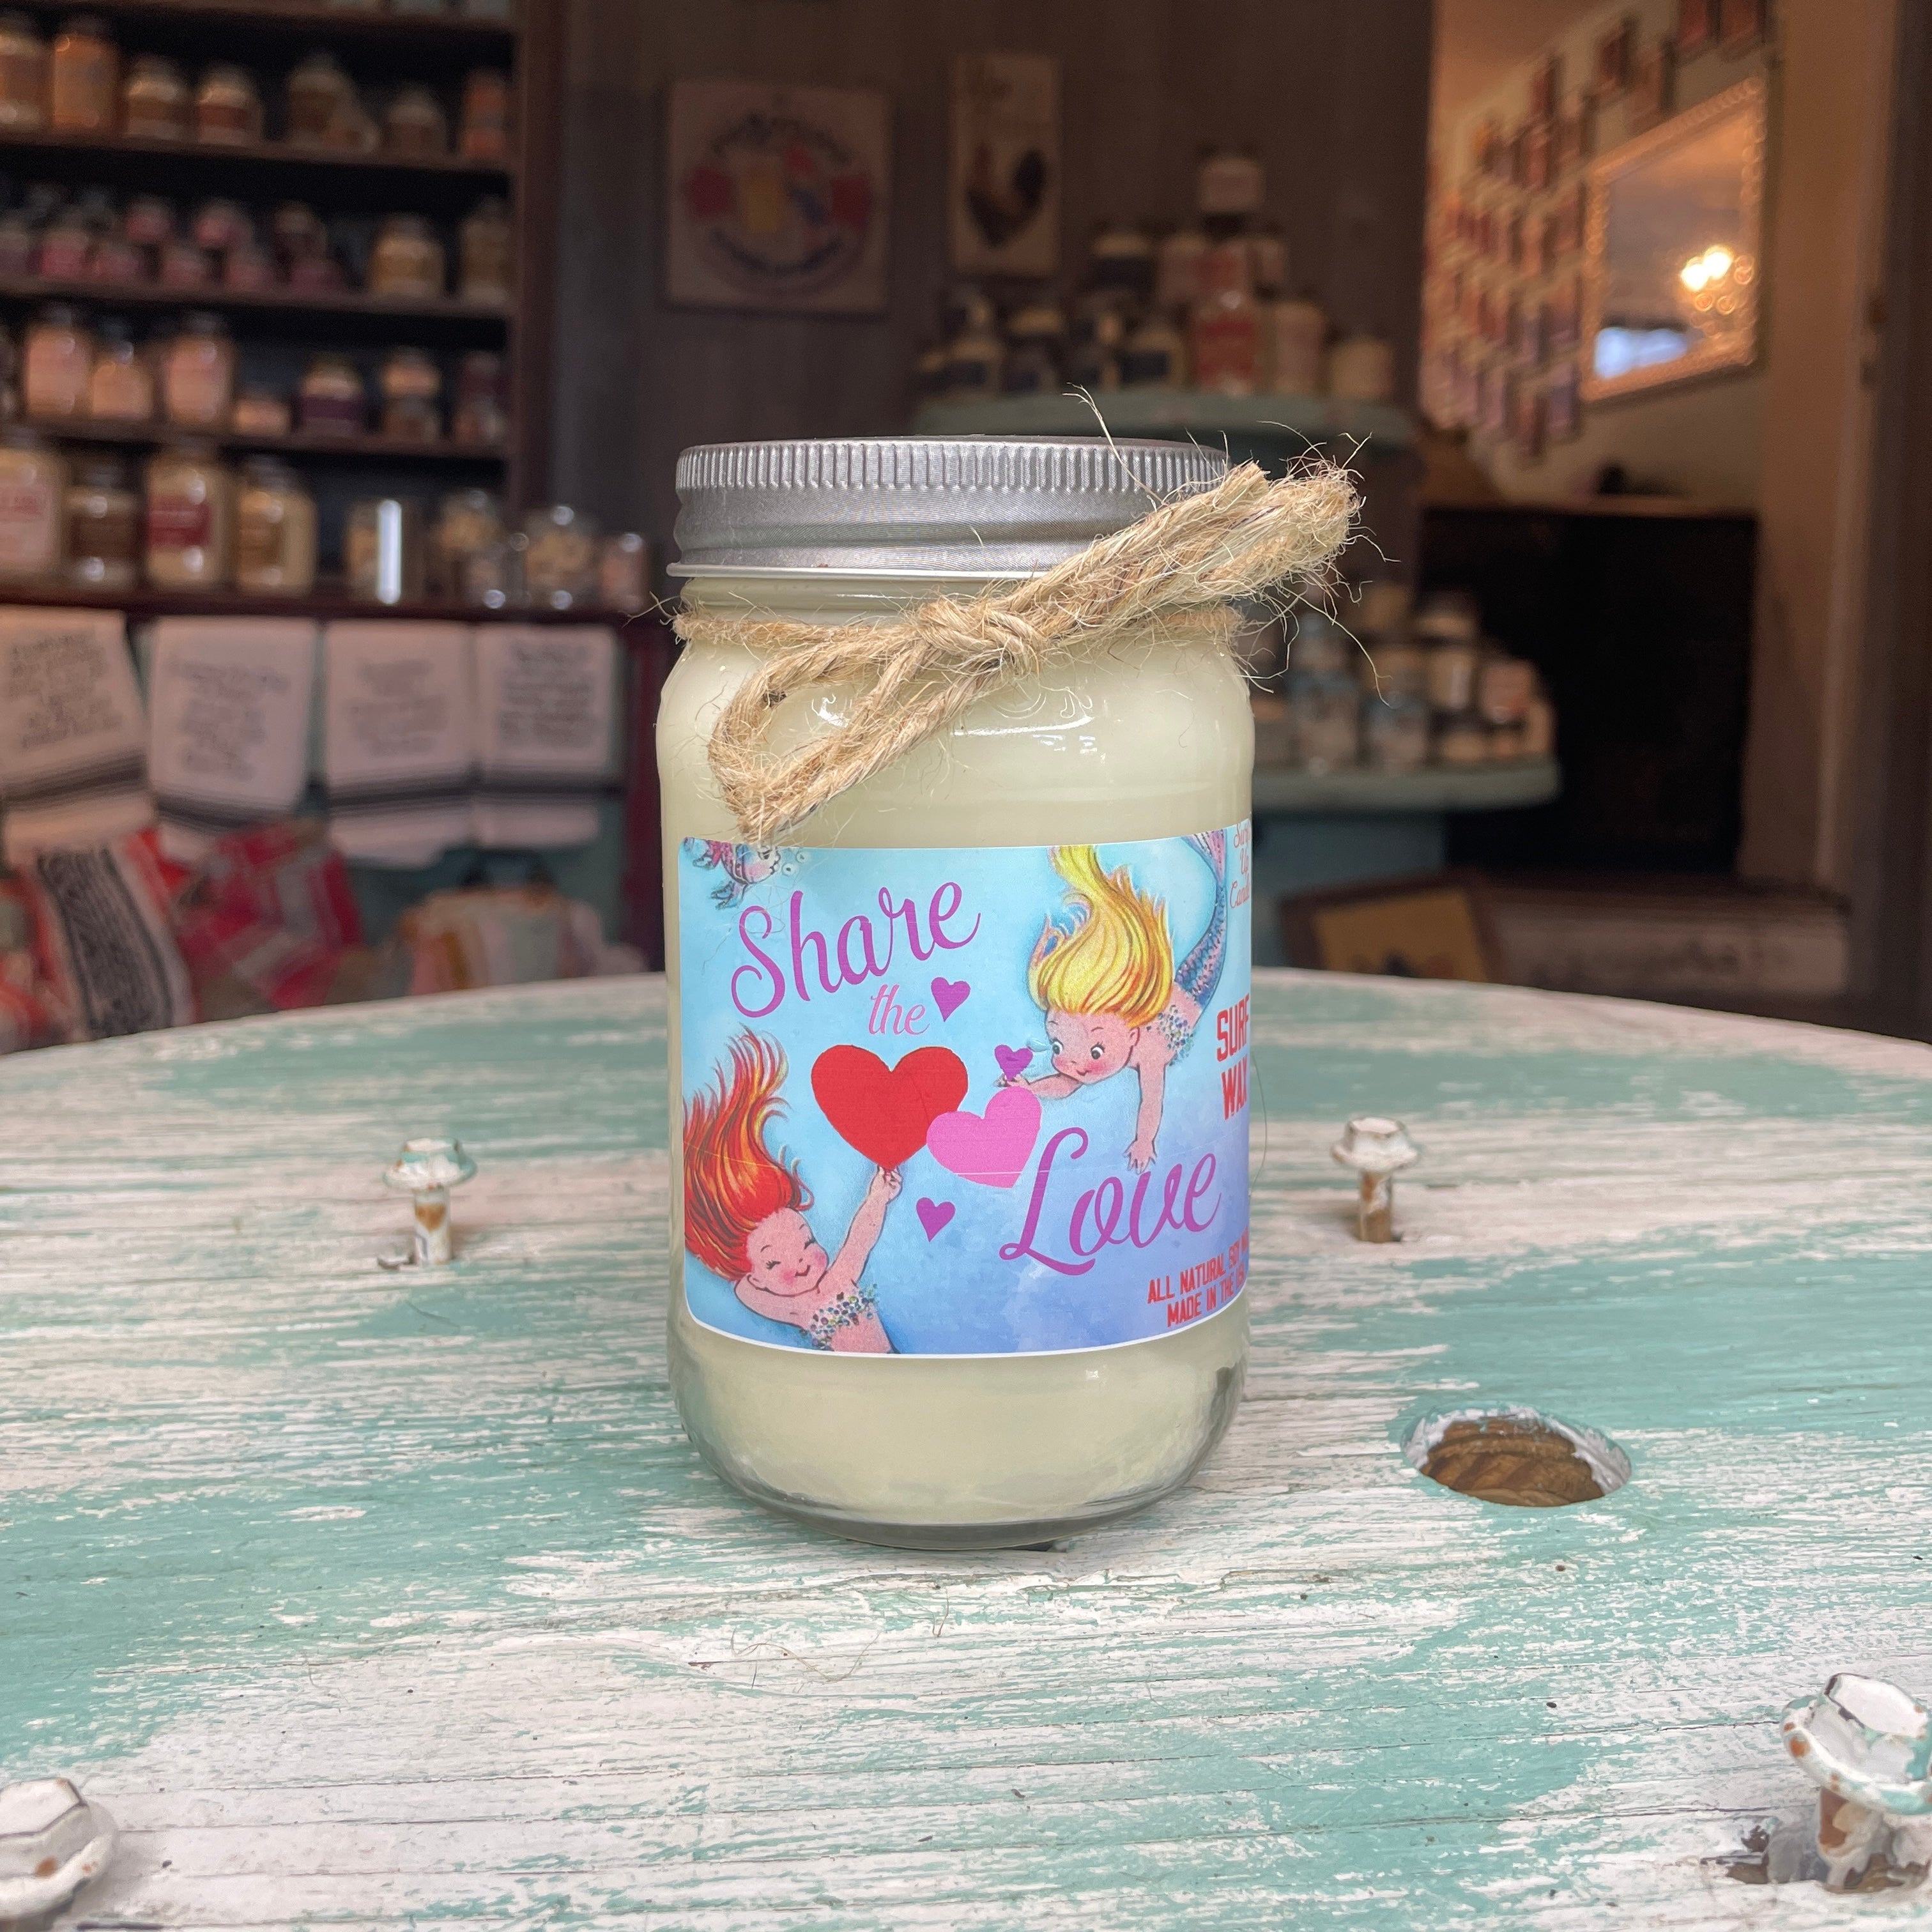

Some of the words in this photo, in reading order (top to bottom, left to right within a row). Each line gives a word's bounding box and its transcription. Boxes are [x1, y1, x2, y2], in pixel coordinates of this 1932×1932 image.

[732, 882, 981, 1018] Share
[868, 984, 930, 1036] the
[1216, 993, 1249, 1062] SURF
[999, 1127, 1222, 1275] Love
[1147, 1275, 1175, 1304] ALL
[1180, 1254, 1226, 1295] NATURAL
[1167, 1292, 1202, 1328] MADE
[1207, 1285, 1216, 1311] IN
[1220, 1272, 1234, 1303] THE
